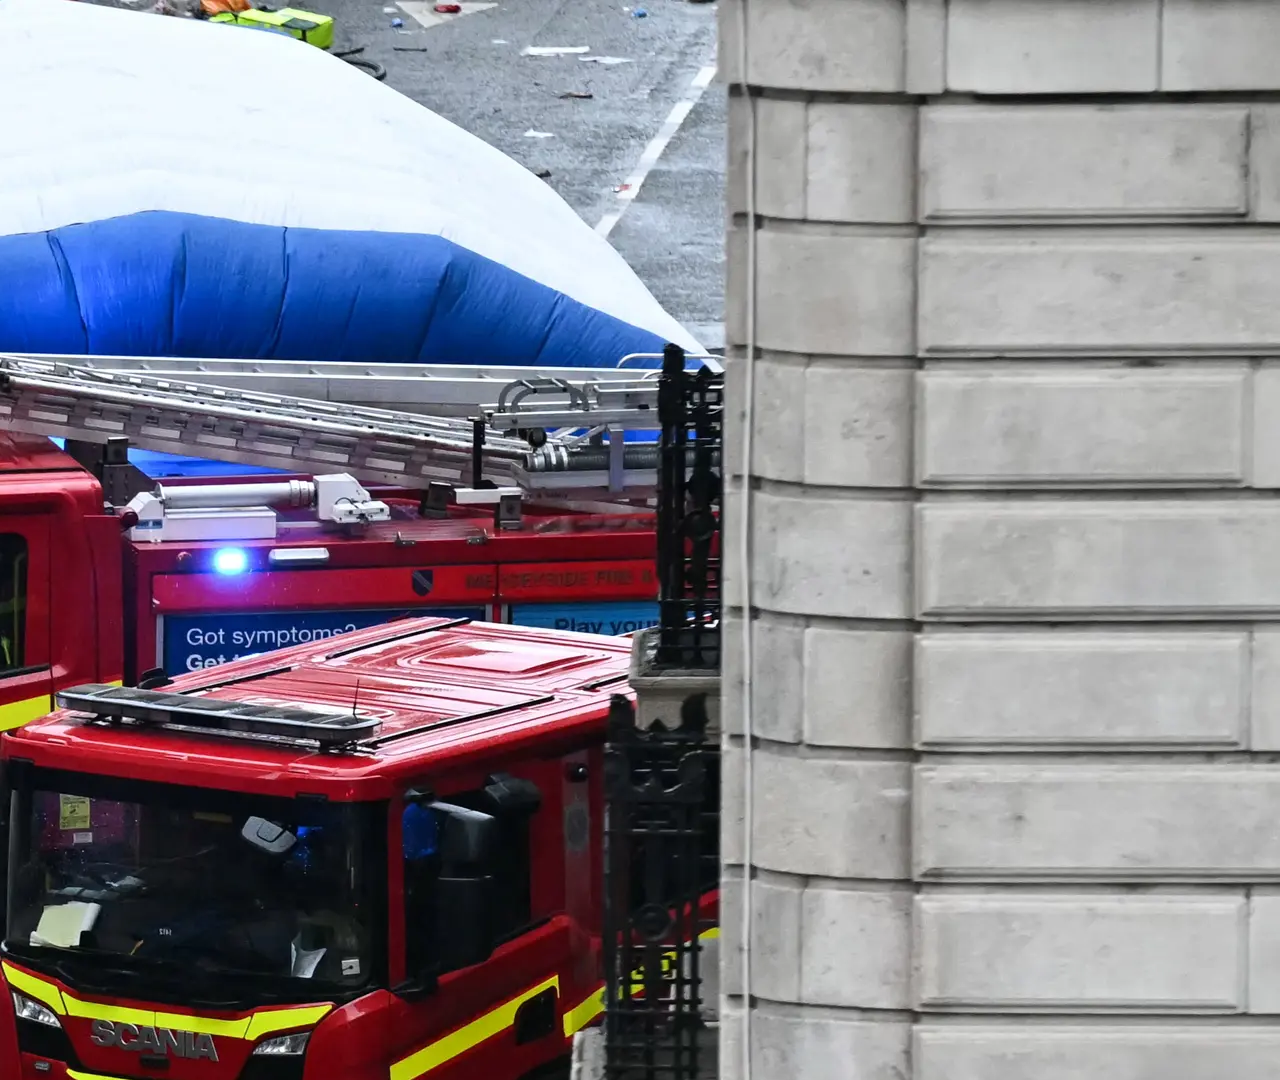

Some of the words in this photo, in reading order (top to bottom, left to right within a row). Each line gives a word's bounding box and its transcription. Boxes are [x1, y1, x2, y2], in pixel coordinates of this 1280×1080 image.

[555, 618, 604, 635] Play
[186, 627, 226, 646] Got
[186, 653, 227, 671] Get
[90, 1019, 220, 1062] SCANIA
